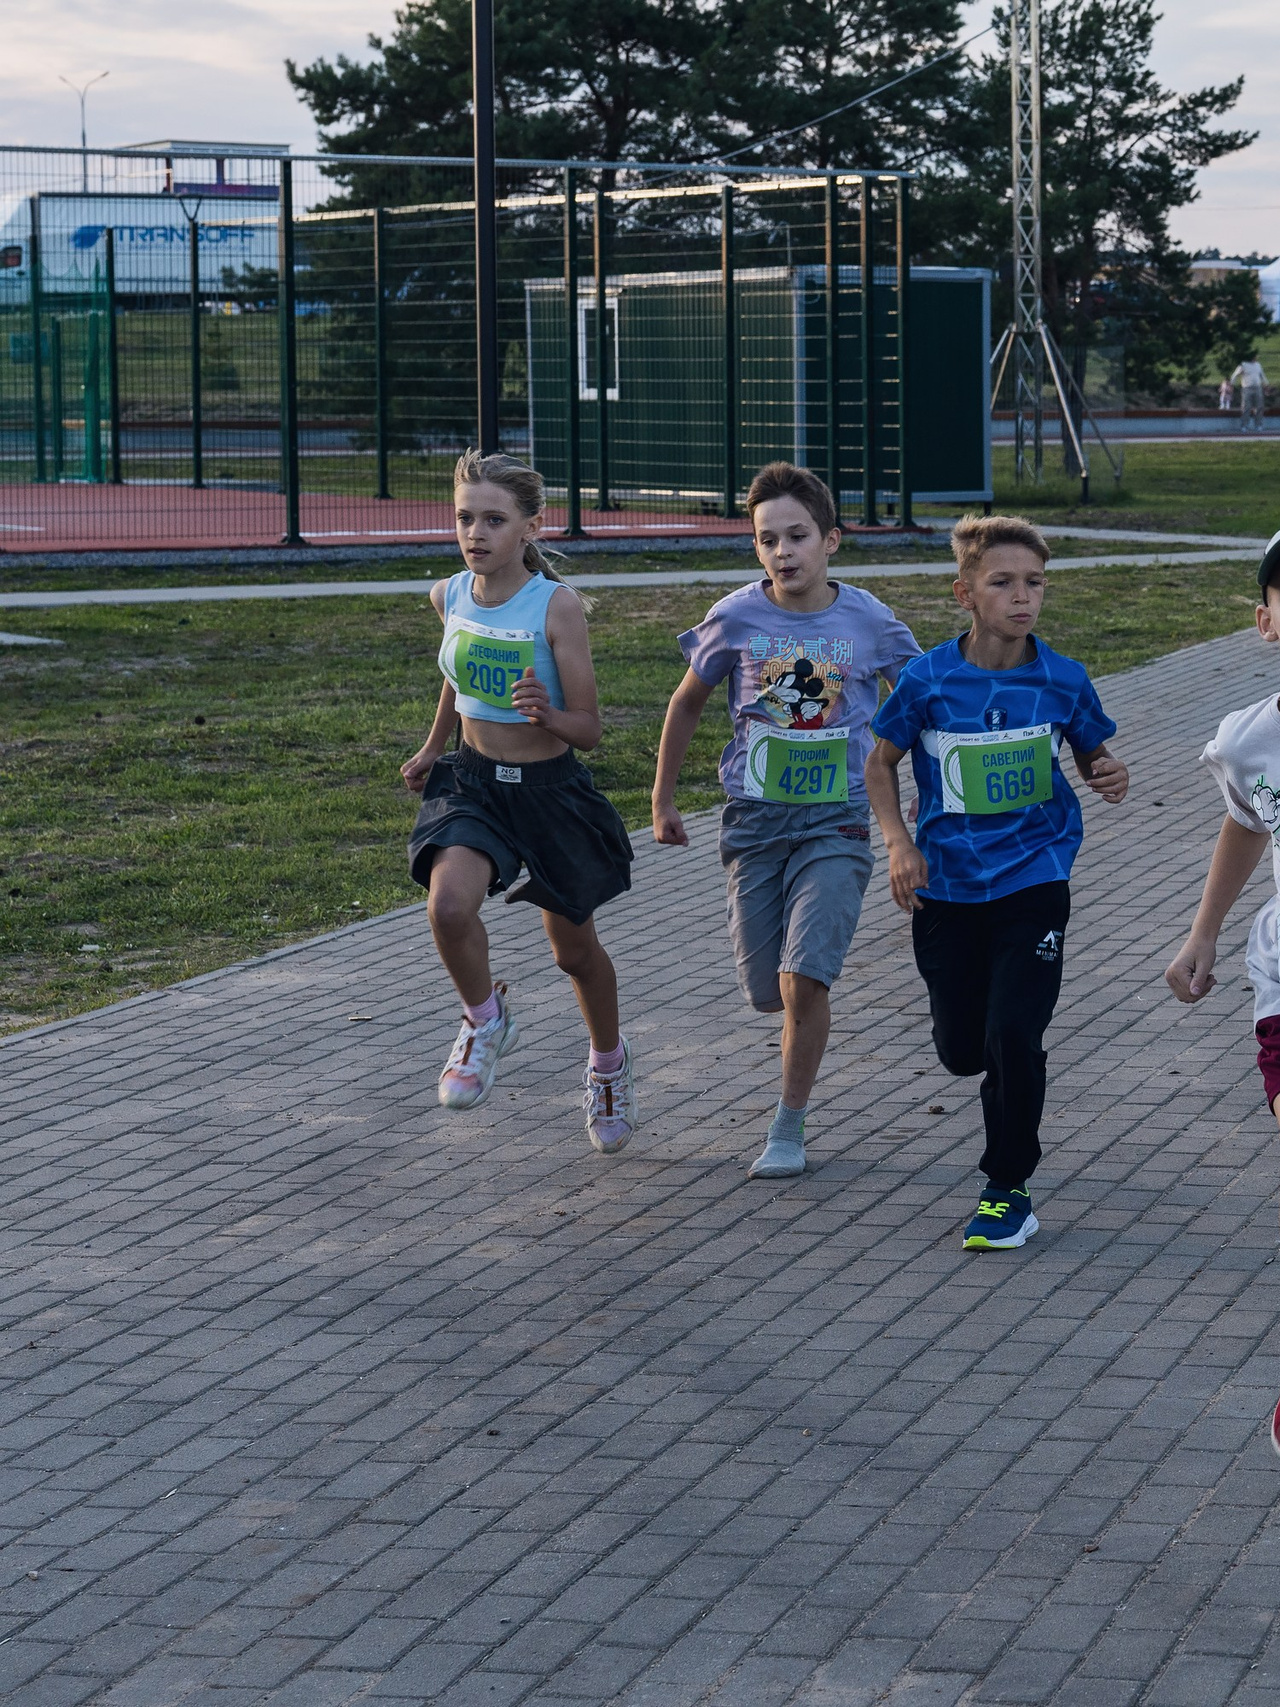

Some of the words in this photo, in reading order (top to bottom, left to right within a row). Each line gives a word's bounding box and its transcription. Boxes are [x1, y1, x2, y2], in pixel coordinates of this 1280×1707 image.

[468, 643, 520, 664] СТЕФАНИЯ
[749, 634, 854, 665] 壹玖贰捌
[466, 661, 524, 697] 2097
[788, 748, 830, 762] ТРОФИМ
[982, 746, 1035, 767] САВЕЛИЙ
[778, 764, 837, 796] 4297
[985, 766, 1035, 804] 669
